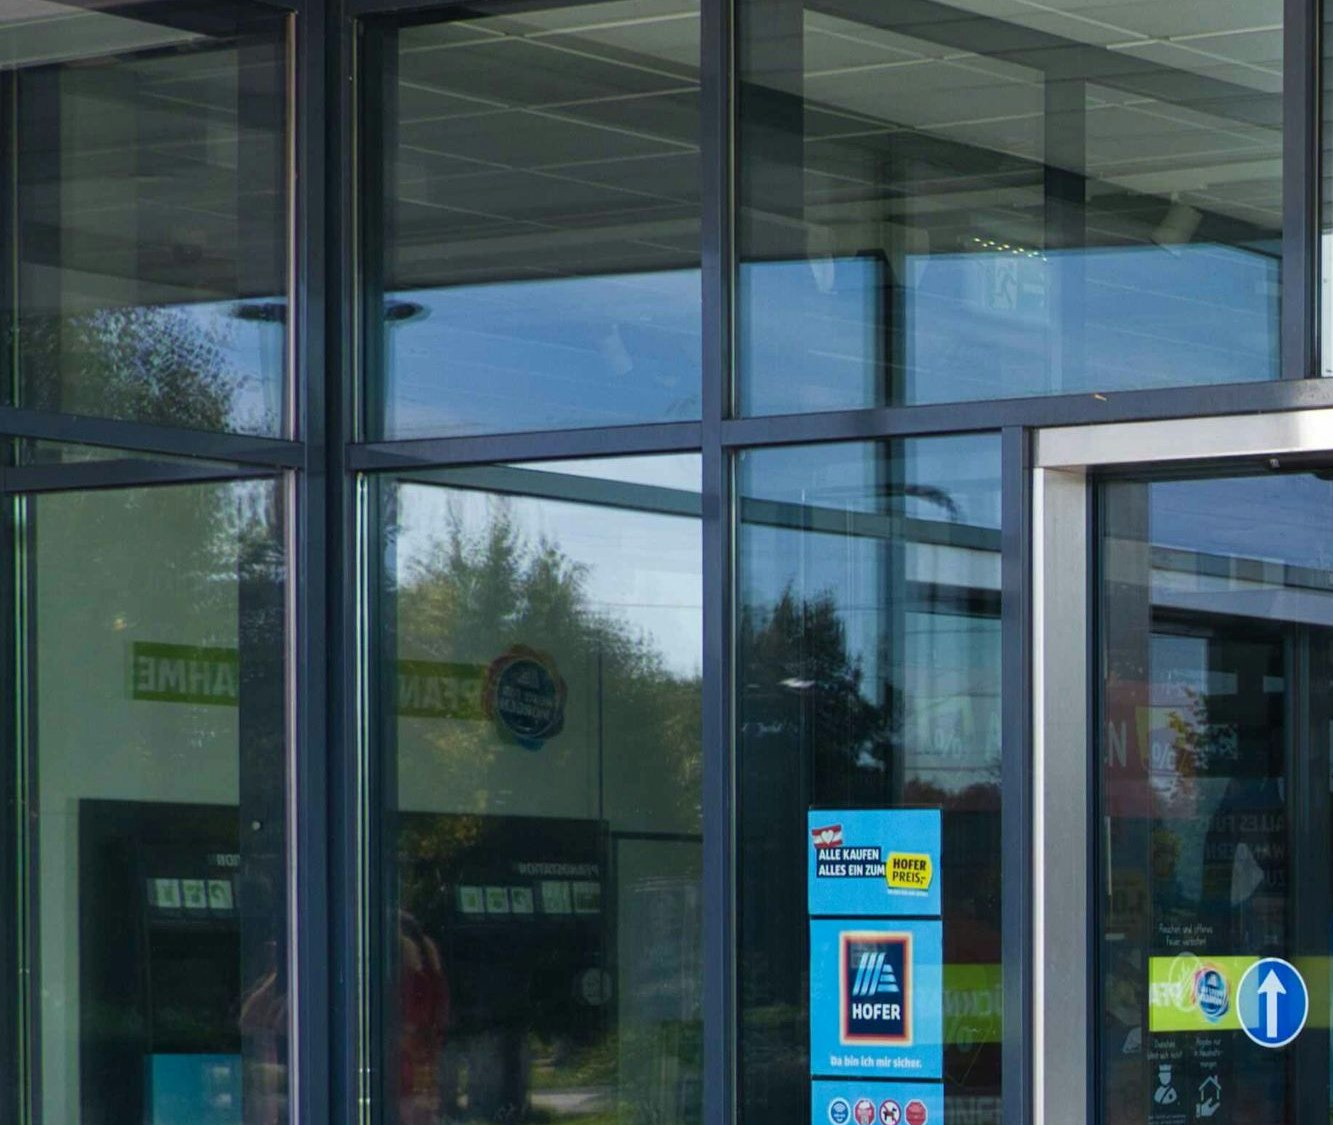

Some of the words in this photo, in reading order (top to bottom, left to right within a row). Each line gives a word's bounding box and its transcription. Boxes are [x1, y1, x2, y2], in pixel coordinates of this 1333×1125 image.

[818, 849, 841, 860] ALLE
[842, 849, 879, 861] KAUFEN
[818, 864, 847, 876] ALLES
[848, 864, 863, 876] EIN
[865, 864, 885, 876] ZUM
[893, 858, 926, 871] HOFER
[852, 1003, 901, 1020] HOFER
[830, 1056, 842, 1067] Da
[844, 1055, 859, 1067] bin
[860, 1056, 874, 1067] ich
[876, 1056, 891, 1068] mir
[893, 1056, 922, 1069] sicher.
